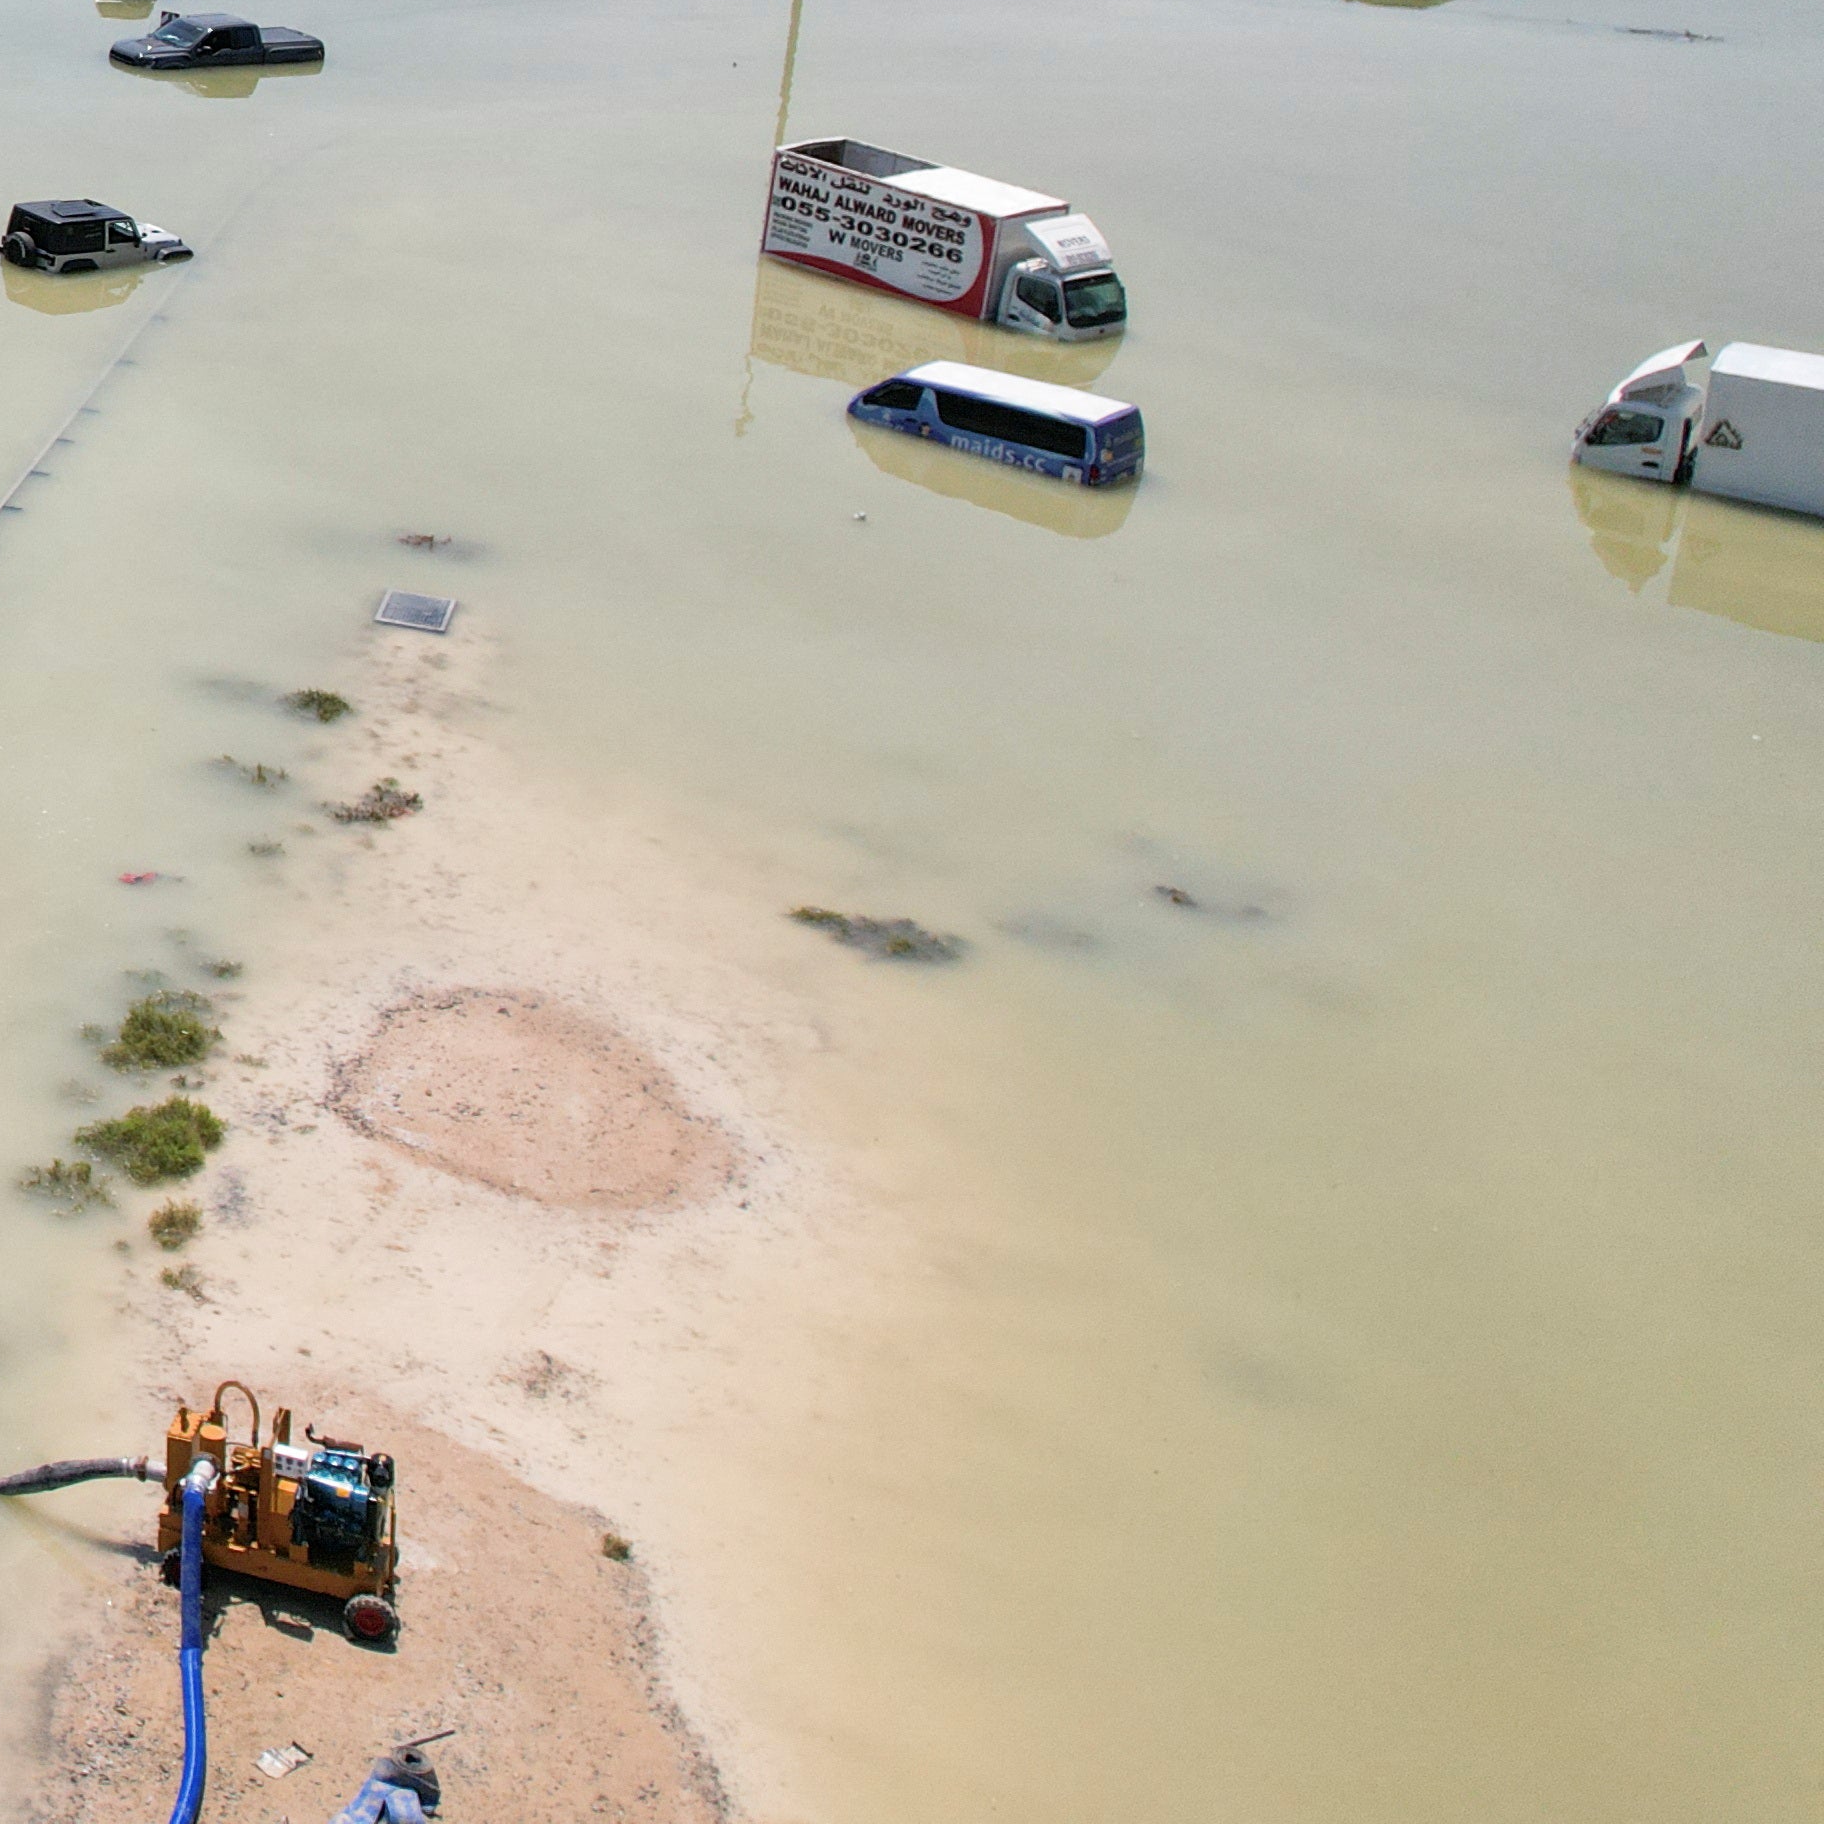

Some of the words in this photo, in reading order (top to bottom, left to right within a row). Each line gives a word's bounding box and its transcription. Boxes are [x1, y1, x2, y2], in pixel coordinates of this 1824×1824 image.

[779, 176, 830, 203] WAHAJ
[834, 195, 897, 224] ALWARD
[902, 215, 965, 246] MOVERS
[781, 196, 963, 263] 055-3030266
[829, 228, 846, 245] W
[851, 236, 903, 262] MOVERS
[952, 435, 1047, 472] maids.cc
